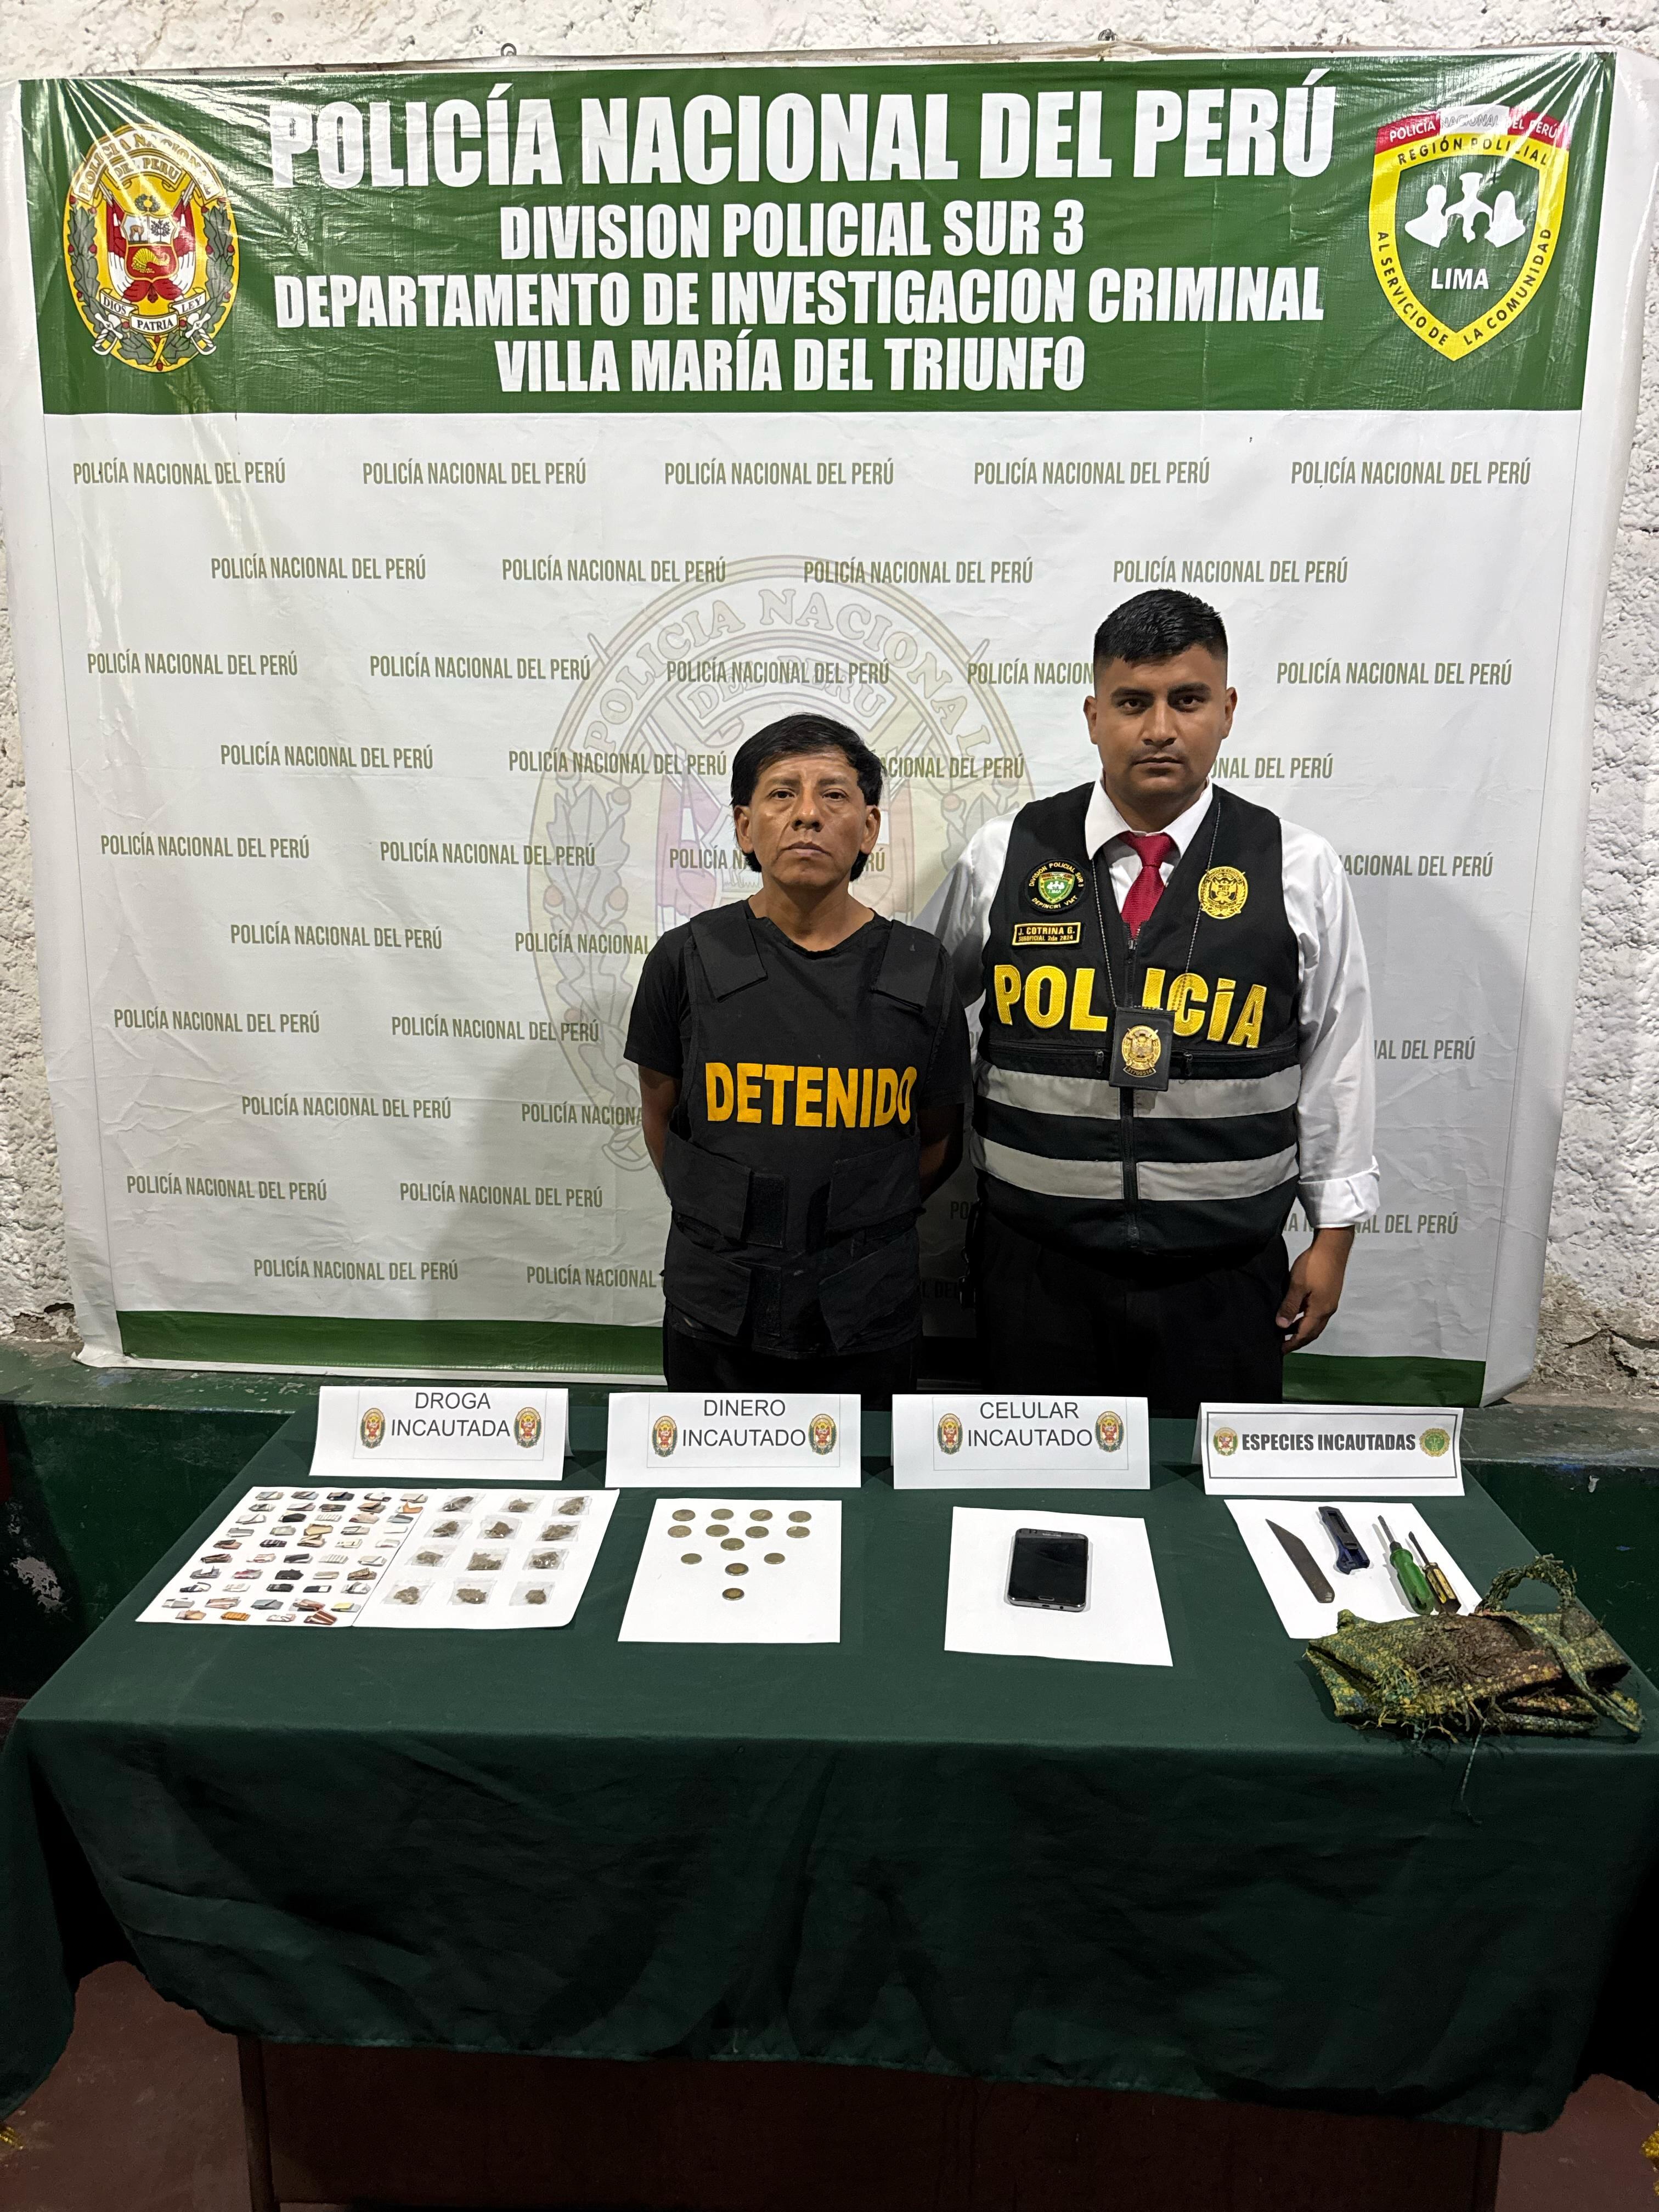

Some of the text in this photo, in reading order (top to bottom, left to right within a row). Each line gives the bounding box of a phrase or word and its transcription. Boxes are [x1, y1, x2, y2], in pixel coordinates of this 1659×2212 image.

[268, 69, 1336, 189] POLICÍA NACIONAL DEL PERÚ
[1398, 137, 1463, 165] REGIÓN
[143, 157, 179, 180] PERU
[500, 199, 1084, 259] DIVISION POLICIAL SUR 3
[1378, 228, 1551, 346] AL SERVICIO DE LA COMUNIDAD
[1430, 268, 1489, 290] LIMA
[102, 296, 127, 315] DIOS
[181, 296, 203, 313] LEY
[274, 267, 1324, 328] DEPARTAMENTO DE INVESTIGACION CRIMINAL
[137, 317, 174, 331] PATRIA
[494, 329, 1085, 392] VILLA MARÍA DEL TRIUNFO
[74, 458, 285, 484] POLICÍA NACIONAL DEL PERÚ
[363, 458, 585, 484] POLICÍA NACIONAL DEL PERÚ
[665, 458, 893, 484] POLICÍA NACIONAL DEL PERÚ
[974, 457, 1209, 484] POLICÍA NACIONAL DEL PERÚ
[1291, 456, 1531, 484] POLICÍA NACIONAL DEL PERÚ
[212, 553, 425, 579] POLICÍA NACIONAL DEL PERÚ
[503, 555, 725, 583] POLICÍA NACIONAL DEL PERÚ
[804, 556, 1032, 583] POLICÍA NACIONAL DEL PERÚ
[1114, 556, 1347, 583] POLICÍA NACIONAL DEL PERÚ
[88, 648, 297, 675] POLICÍA NACIONAL DEL PERÚ
[370, 652, 590, 680] POLICÍA NACIONAL DEL PERÚ
[667, 657, 889, 684] POLICÍA NACIONAL DEL PERÚ
[758, 588, 991, 759] NACIONAL
[1277, 658, 1511, 685] POLICÍA NACIONAL DEL PERÚ
[221, 741, 432, 769] POLICÍA NACIONAL DEL PERÚ
[509, 748, 726, 775] POLICÍA NACIONAL DEL PERÚ
[101, 832, 309, 858] POLICÍA NACIONAL DEL PERÚ
[381, 838, 595, 866] POLICÍA NACIONAL DEL PERÚ
[1048, 862, 1076, 873] POLICIAL
[1031, 895, 1079, 909] DEPINCRI VMT
[231, 921, 442, 949] POLICÍA NACIONAL DEL PERÚ
[515, 929, 650, 955] POLICÍA NACIONAL
[1026, 927, 1065, 935] COTRINA
[114, 1006, 319, 1032] POLICÍA NACIONAL DEL PERÚ
[392, 1014, 599, 1042] POLICÍA NACIONAL DEL PERÚ
[242, 1093, 450, 1119] POLICÍA NACIONAL DEL PERÚ
[706, 1062, 917, 1128] DETENIDO
[127, 1173, 326, 1200] POLICÍA NACIONAL DEL PERÚ
[400, 1181, 602, 1207] POLICÍA NACIONAL DEL PERÚ
[255, 1256, 458, 1280] POLICÍA NACIONAL DEL PERÚ
[415, 1392, 491, 1409] DROGA
[703, 1399, 786, 1417] DINERO
[980, 1402, 1080, 1419] CELULAR
[391, 1419, 511, 1436] INCAUTADA
[682, 1429, 806, 1447] INCAUTADO
[968, 1429, 1093, 1447] INCAUTADO
[1242, 1434, 1416, 1451] ESPECIES INCAUTADAS
